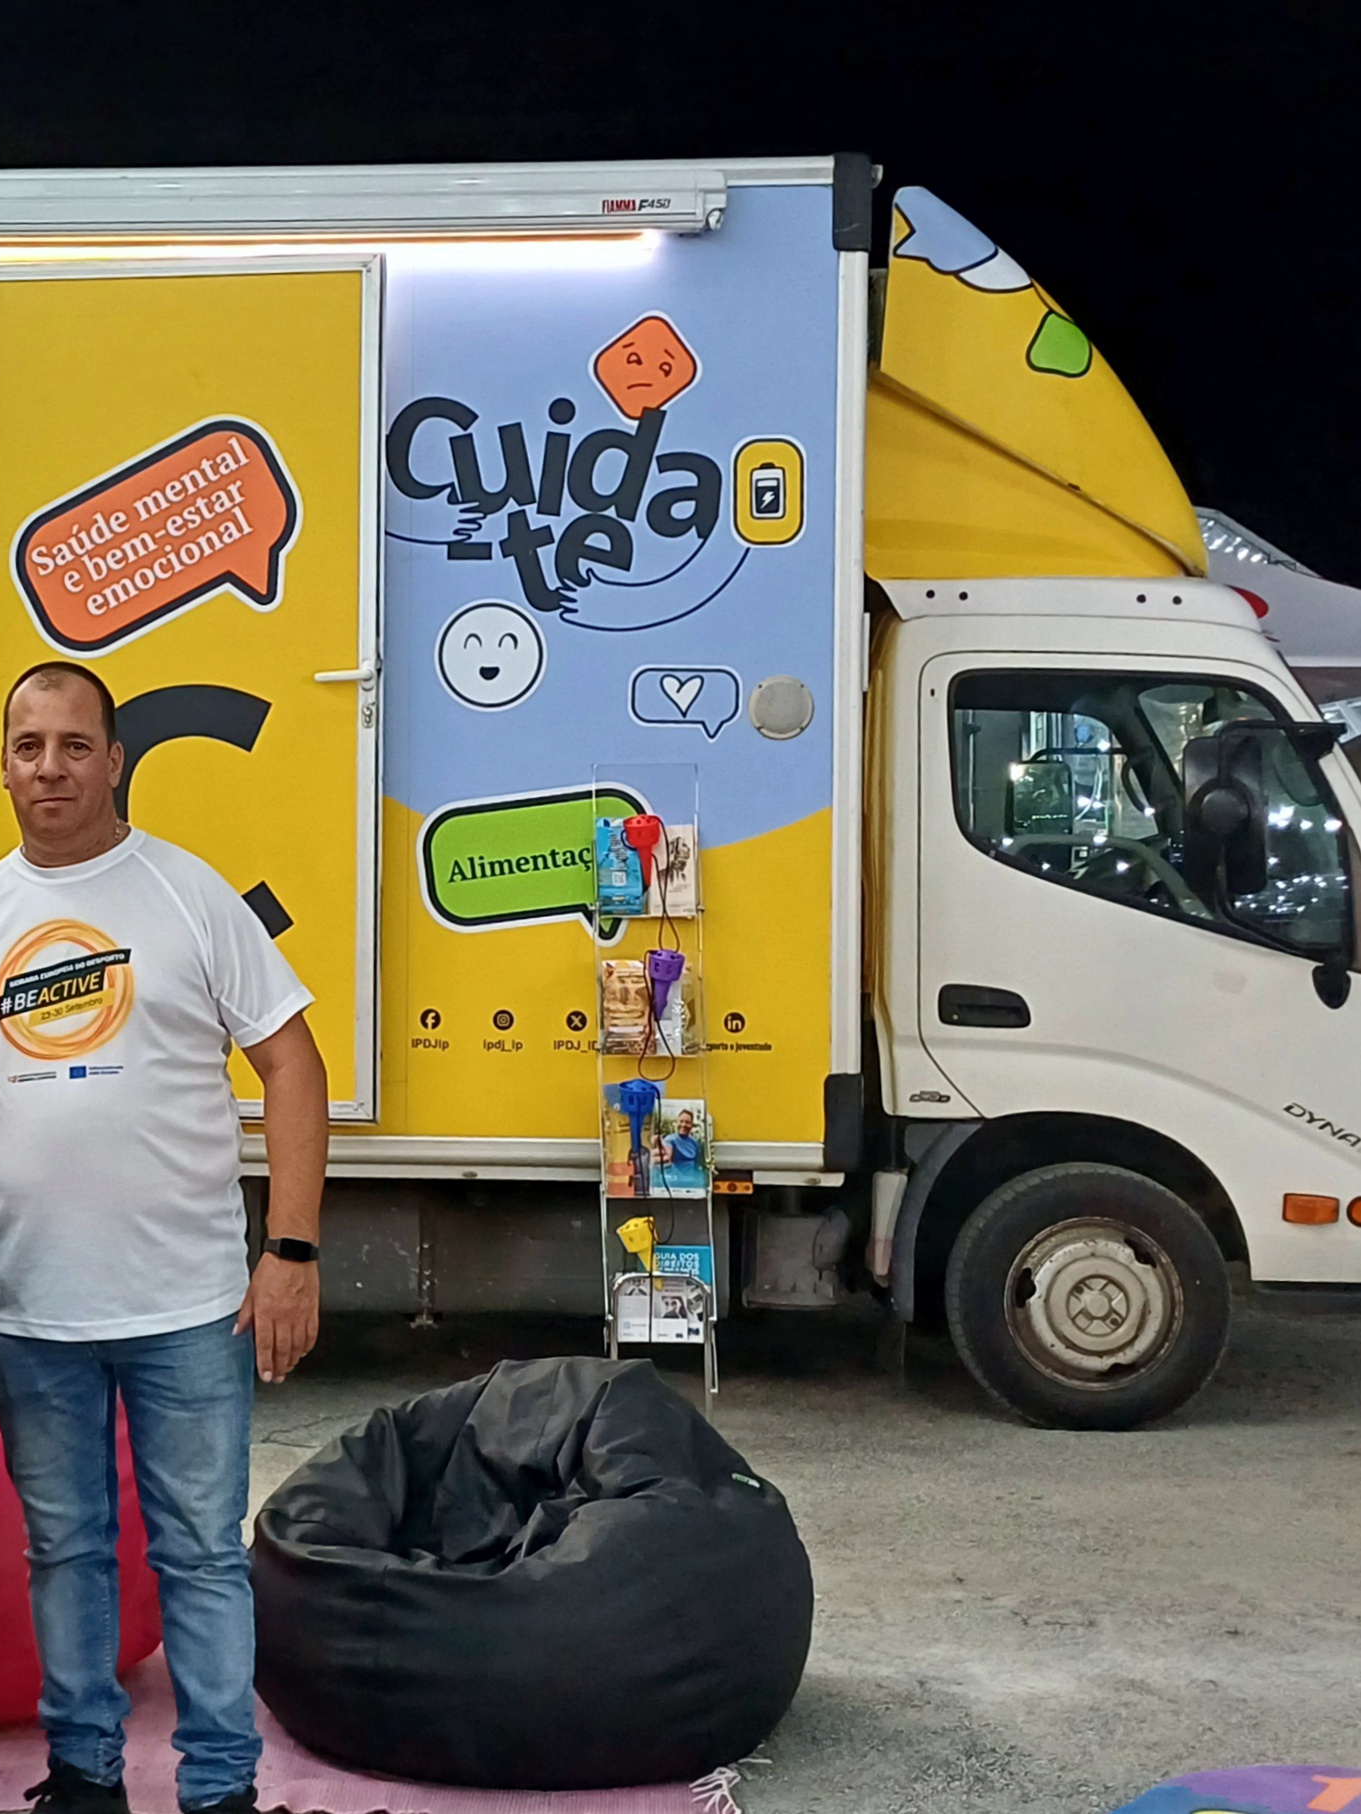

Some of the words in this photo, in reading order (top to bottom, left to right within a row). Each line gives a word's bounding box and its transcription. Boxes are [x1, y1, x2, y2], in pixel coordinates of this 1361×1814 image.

[602, 199, 637, 213] FIAMMA
[386, 396, 722, 539] Cuida
[30, 511, 130, 577] Saúde
[132, 436, 250, 522] mental
[63, 569, 85, 593] e
[81, 480, 246, 582] bem-estar
[86, 505, 254, 616] emocional
[447, 847, 594, 884] Alimentaç
[0, 971, 102, 1016] #BEACTIVE
[65, 996, 104, 1014] Setembro
[1282, 1102, 1361, 1148] DYNA
